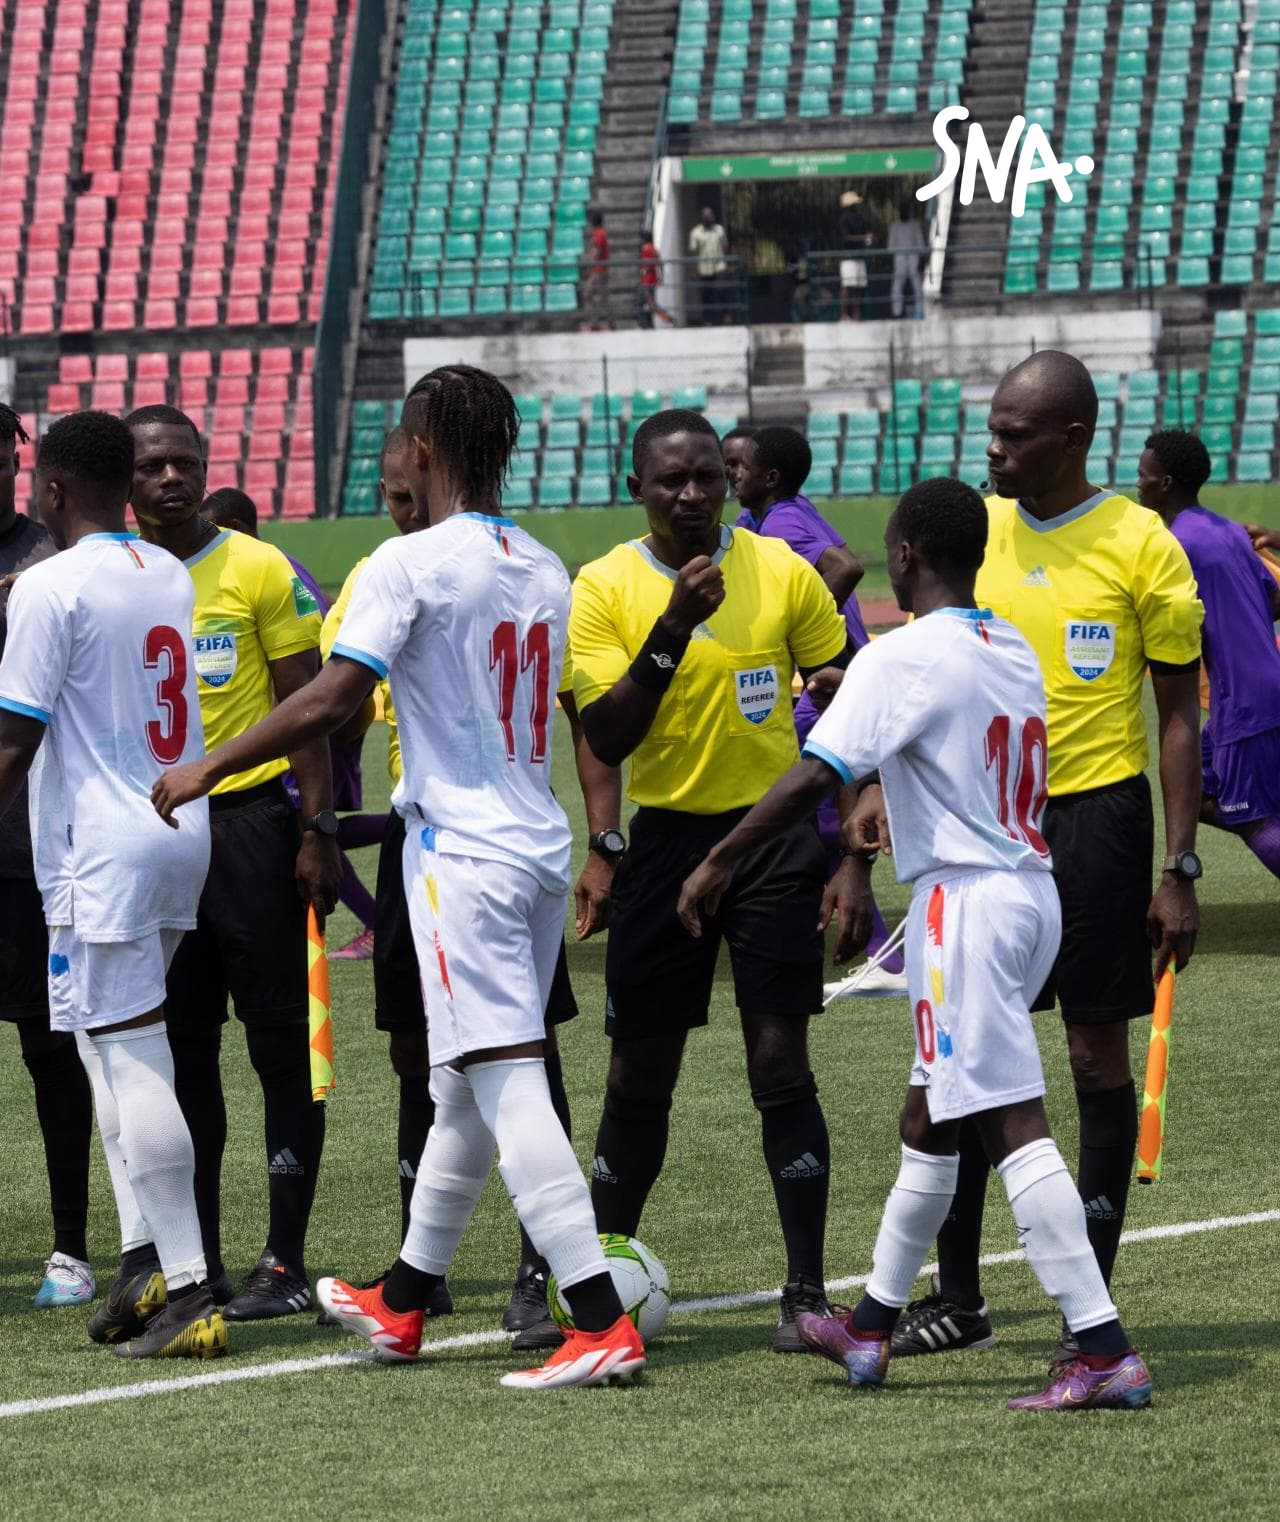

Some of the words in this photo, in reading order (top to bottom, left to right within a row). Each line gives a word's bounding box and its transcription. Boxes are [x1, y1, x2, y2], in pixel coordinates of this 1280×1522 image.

[1070, 625, 1111, 640] FIFA
[195, 636, 234, 652] FIFA
[739, 669, 775, 689] FIFA
[1080, 667, 1099, 676] 2024
[208, 675, 227, 684] 2024
[143, 625, 188, 766] 3
[489, 621, 550, 764] 11
[740, 691, 776, 705] REFEREE
[750, 711, 767, 722] 2024
[984, 715, 1051, 860] 10
